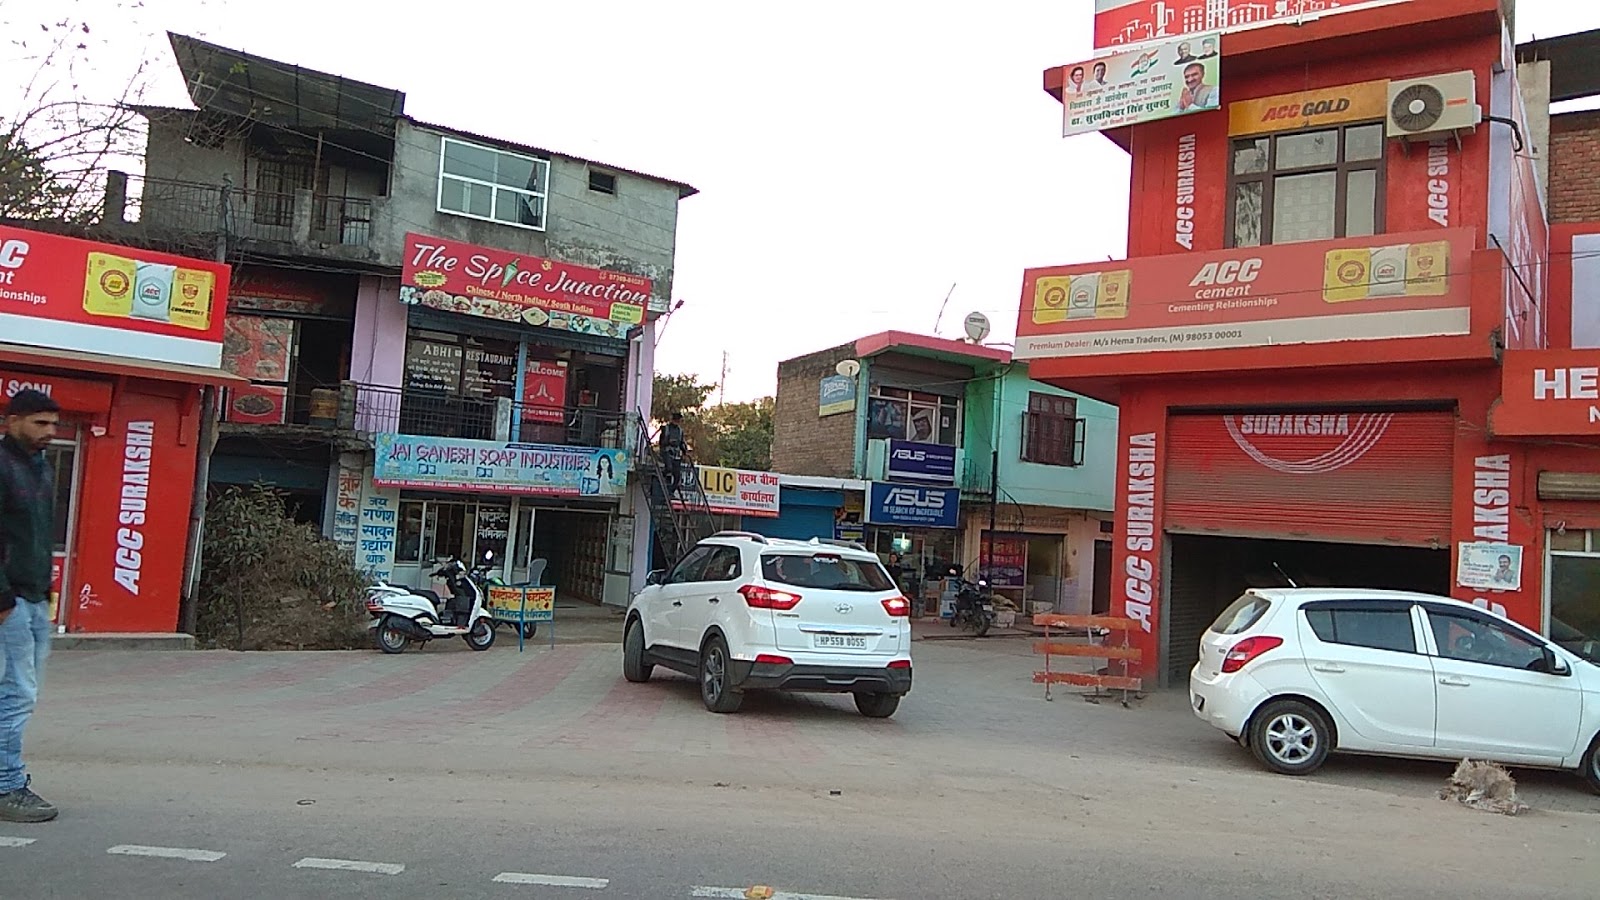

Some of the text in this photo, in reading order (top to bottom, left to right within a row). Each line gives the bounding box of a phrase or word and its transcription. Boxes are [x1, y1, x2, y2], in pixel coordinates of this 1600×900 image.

[1261, 97, 1351, 122] ACC GOLD
[1175, 133, 1196, 251] ACC SURAKSHA
[1427, 178, 1449, 228] ACC
[412, 243, 458, 271] The
[544, 270, 647, 304] Junction
[1188, 258, 1263, 288] ACC
[465, 285, 495, 298] Chinese
[501, 291, 523, 302] North
[551, 298, 571, 311] South
[572, 303, 594, 314] Indian
[1195, 284, 1252, 300] cement
[1168, 297, 1278, 314] Cementing Relationships
[1029, 342, 1064, 351] Premium
[1093, 338, 1110, 347] M/s
[1110, 337, 1135, 346] Hema
[1136, 335, 1168, 345] Traders,
[1169, 334, 1185, 344] (M)
[1185, 332, 1213, 342] 98053
[1214, 330, 1243, 340] 00001
[423, 345, 513, 367] ABHI RESTAURANT
[1241, 414, 1349, 435] SURAKSHA
[389, 443, 412, 461] JAI
[416, 445, 476, 465] GANESH
[479, 448, 517, 468] SOAP
[520, 451, 591, 471] INDUSTRIES
[891, 449, 926, 462] ASUS
[704, 470, 733, 493] LIC
[114, 420, 155, 596] ACC SURAKSHA
[368, 496, 388, 507] जय
[740, 489, 776, 504] कार्यालय
[884, 487, 946, 510] ASUS
[363, 507, 395, 524] गणेश
[1125, 431, 1156, 633] ACC SURAKSHA
[361, 537, 393, 552] उद्योग
